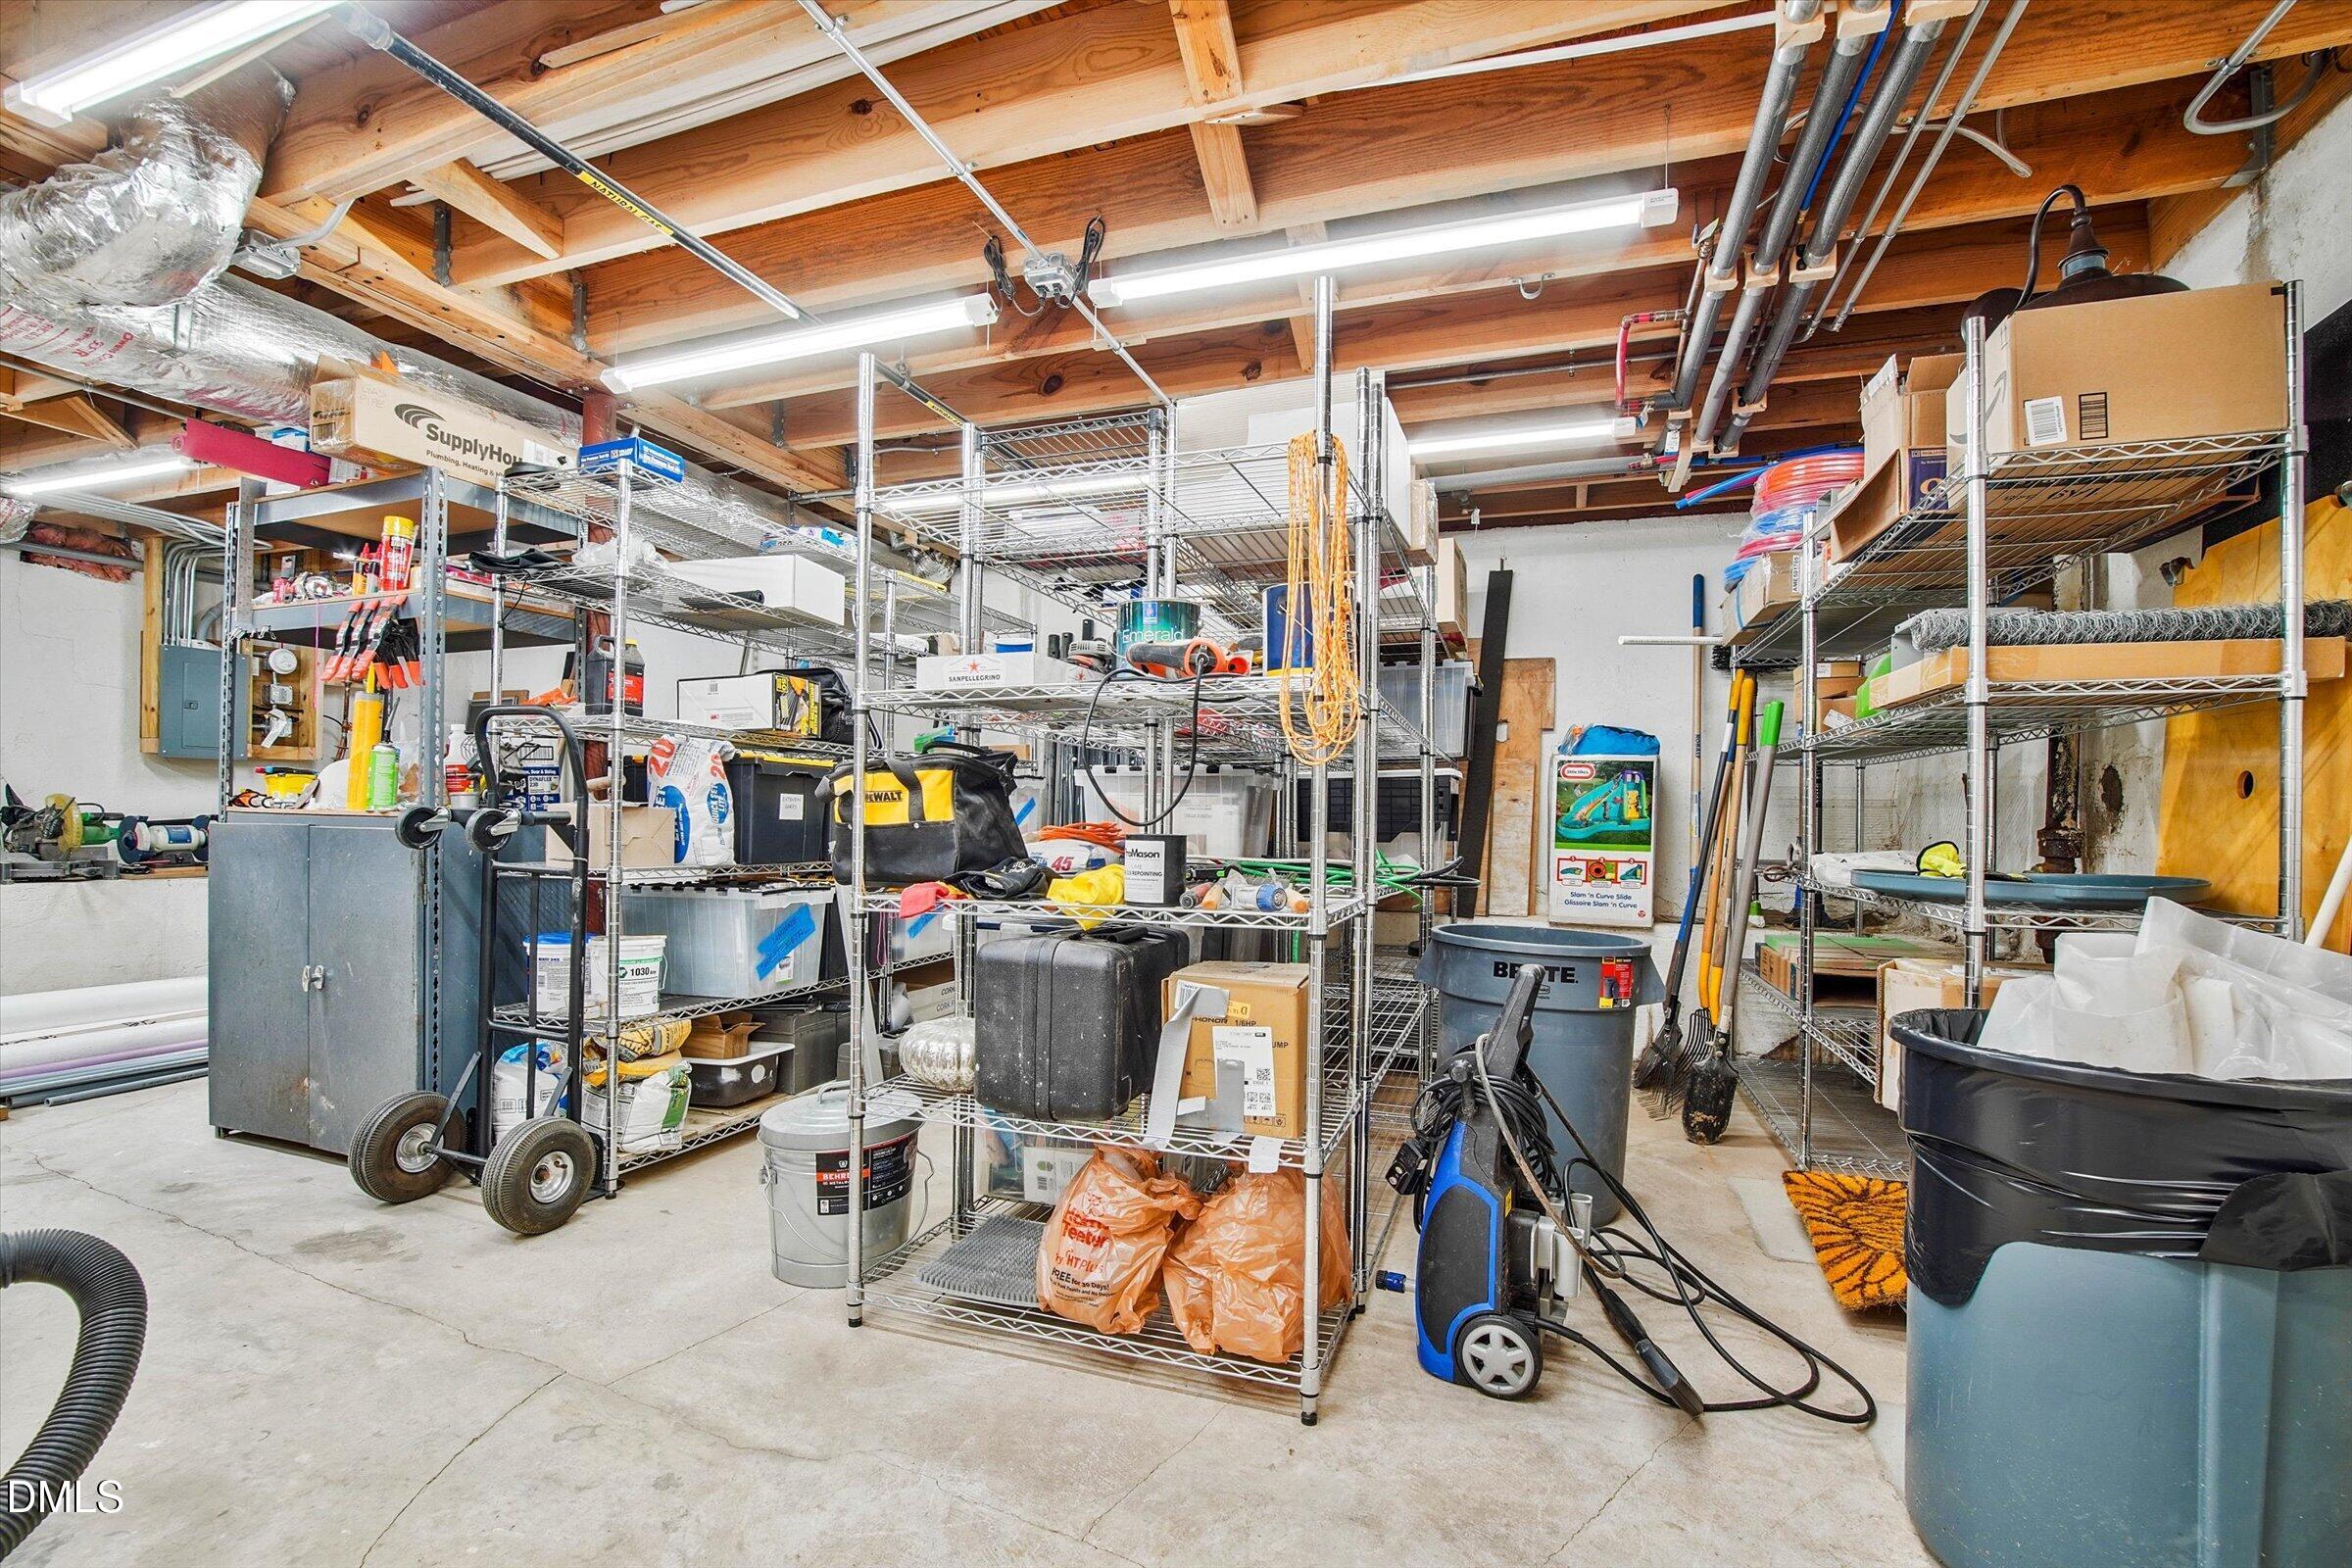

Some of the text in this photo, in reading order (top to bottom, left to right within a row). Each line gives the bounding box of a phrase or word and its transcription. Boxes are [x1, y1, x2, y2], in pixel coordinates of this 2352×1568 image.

[425, 422, 523, 466] SupplyHou
[425, 449, 461, 467] Plumbing,
[462, 460, 489, 477] Heating
[1122, 625, 1184, 643] Emerald
[948, 673, 1001, 683] SANPELLEGRINO
[1051, 856, 1075, 871] 45
[630, 967, 650, 977] 1030
[1494, 960, 1579, 984] BRTE.
[1272, 1041, 1290, 1050] UMP
[1061, 1220, 1108, 1248] Teeter
[1091, 1282, 1109, 1291] Days!
